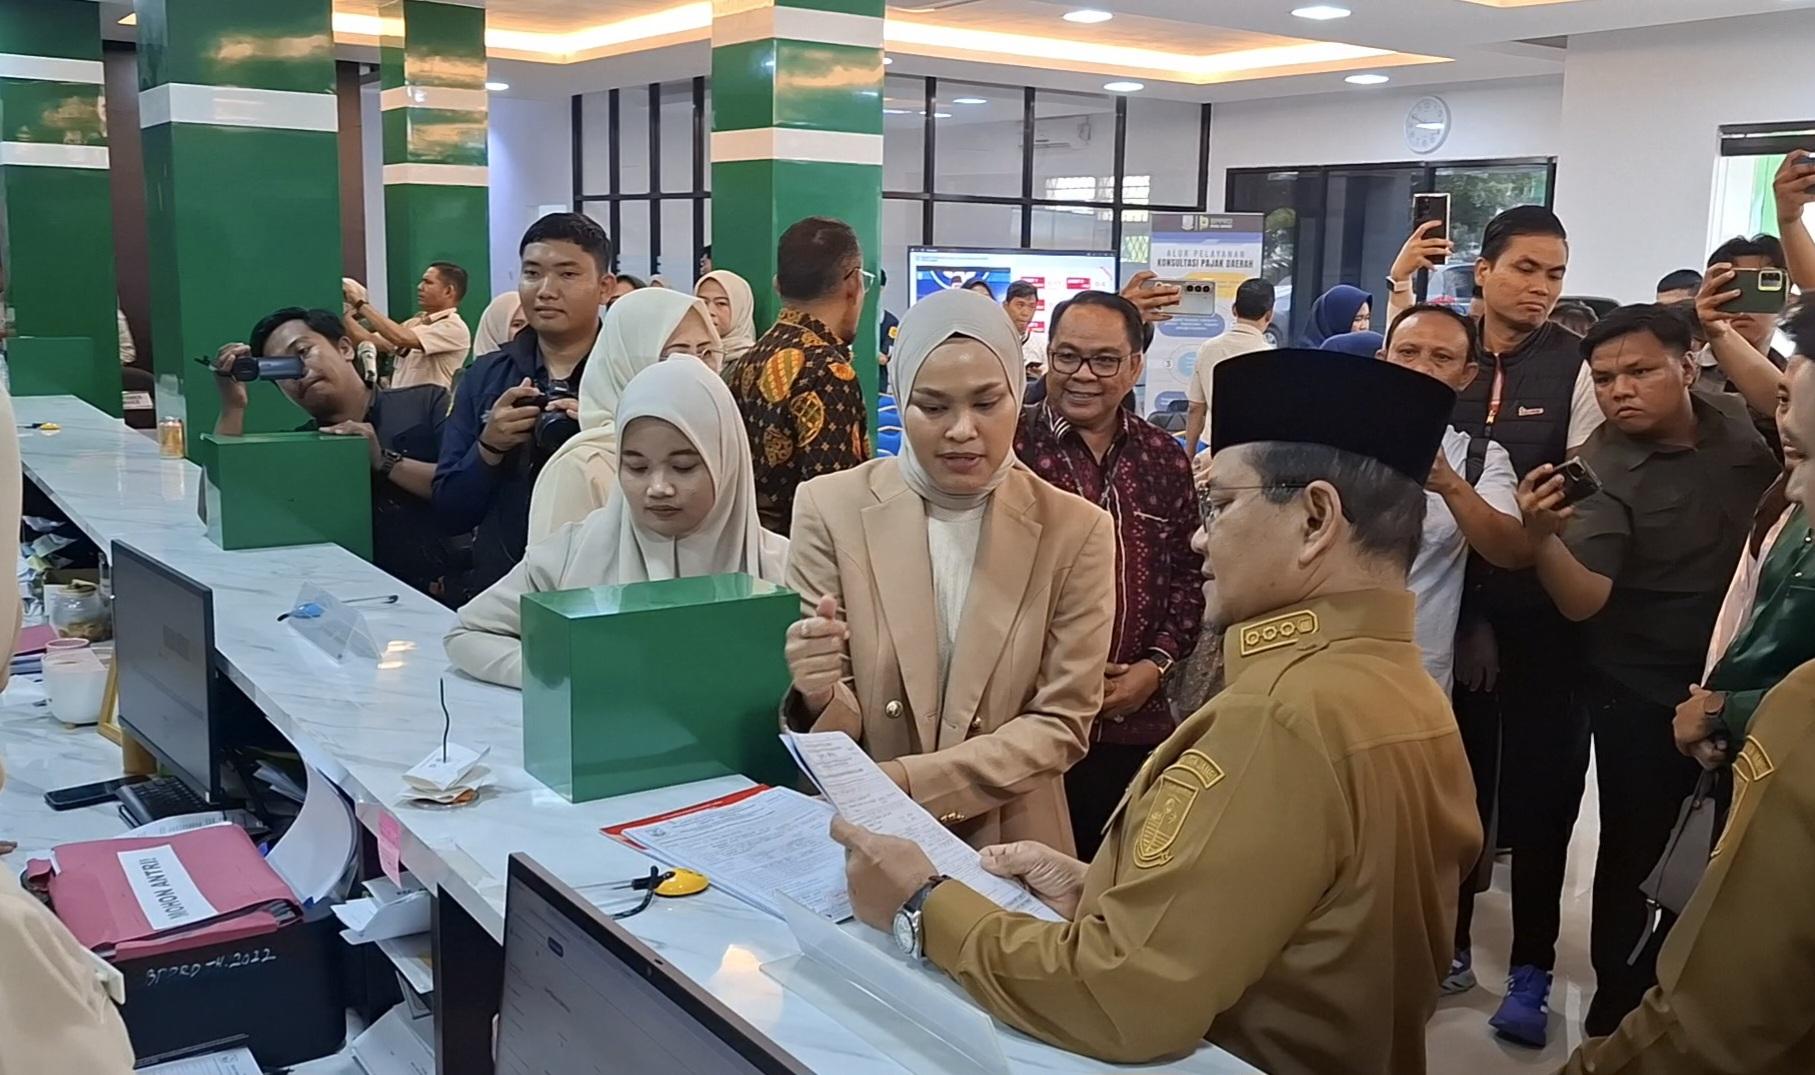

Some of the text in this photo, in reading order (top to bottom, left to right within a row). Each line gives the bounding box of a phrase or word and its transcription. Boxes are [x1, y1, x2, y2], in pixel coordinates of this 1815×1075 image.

[1193, 249, 1246, 258] PELAYANAN
[1157, 258, 1254, 268] KONSULTASI PAJAK DAERAH
[154, 888, 190, 920] MOHON
